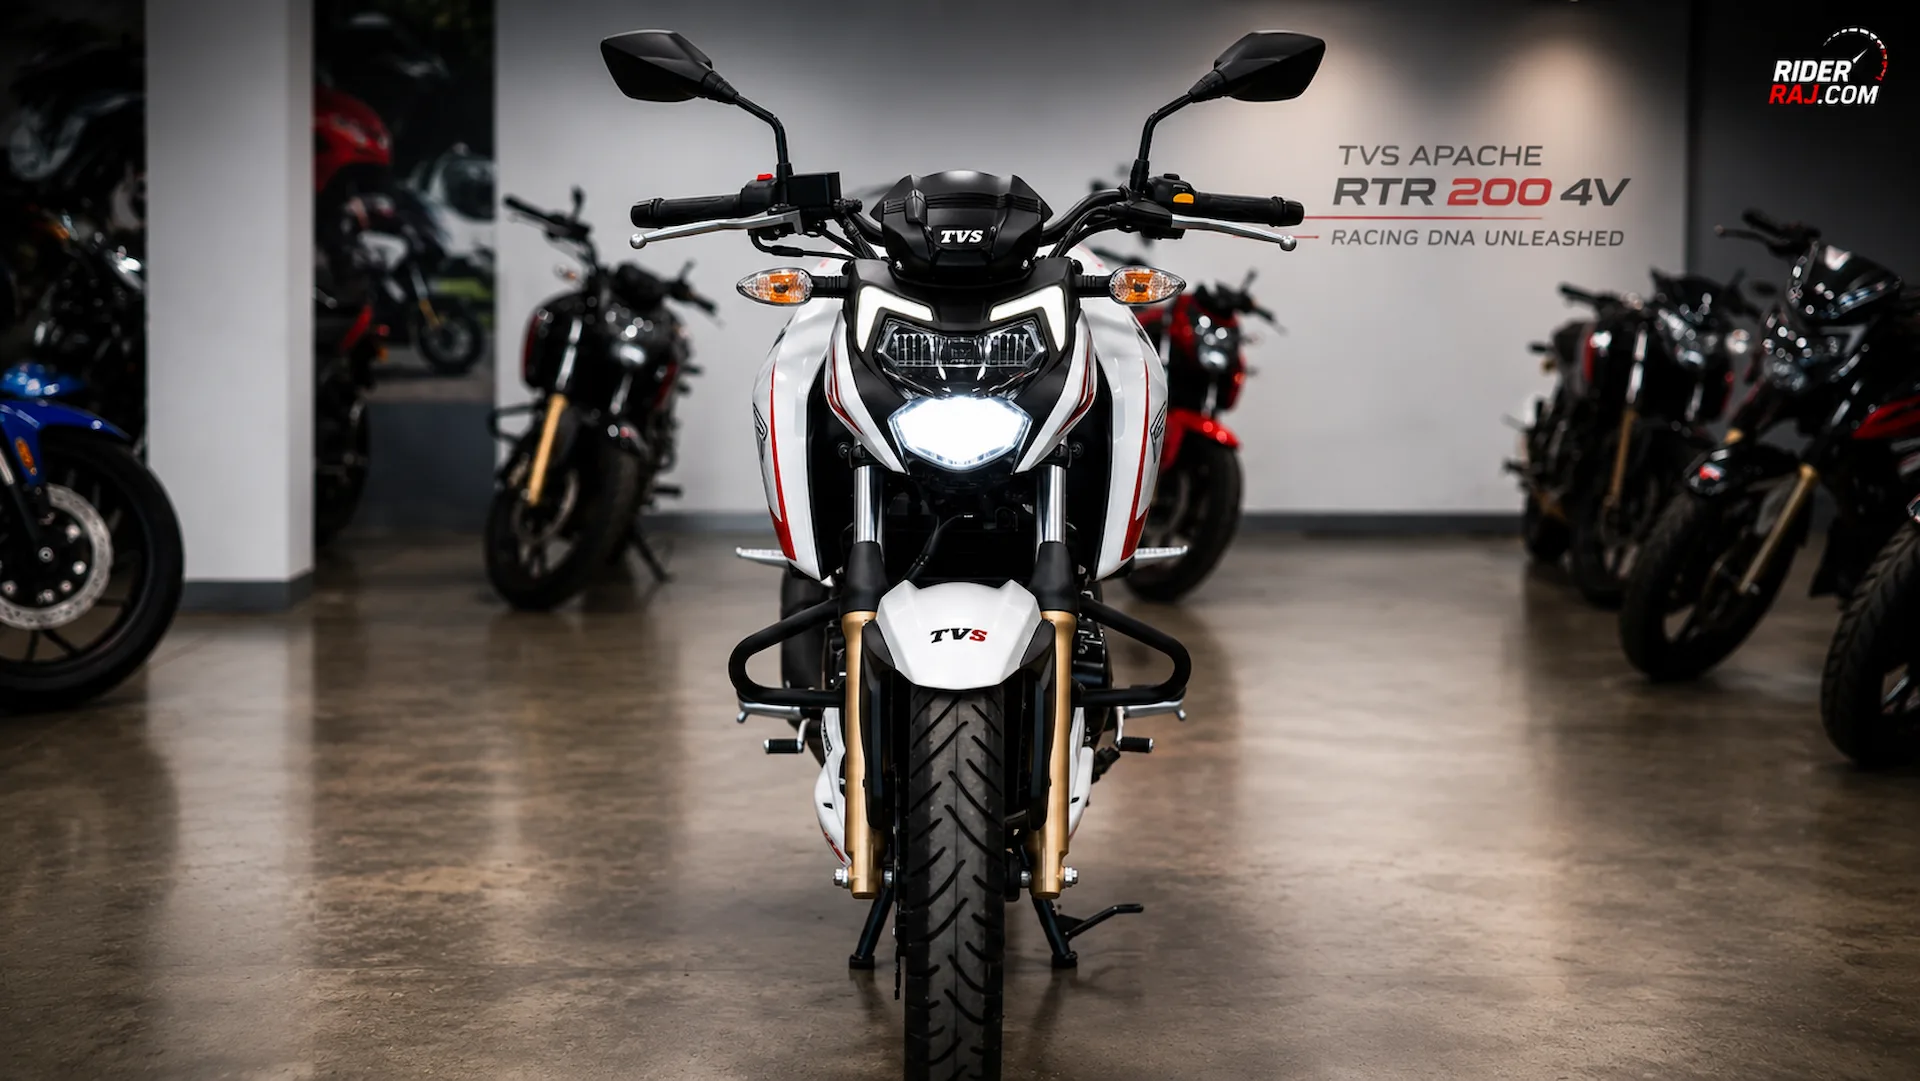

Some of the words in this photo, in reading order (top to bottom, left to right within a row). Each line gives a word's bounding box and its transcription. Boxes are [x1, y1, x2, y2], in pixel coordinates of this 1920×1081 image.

[1338, 145, 1400, 166] TVS
[1408, 145, 1543, 166] APACHE
[1333, 178, 1437, 206] RTR
[1447, 178, 1553, 206] 200
[1560, 178, 1631, 206] 4V
[940, 230, 984, 244] TVS
[1331, 230, 1419, 246] RACING
[1427, 230, 1475, 246] DNA
[1485, 230, 1625, 246] UNLEASHED
[930, 628, 988, 644] TVS
